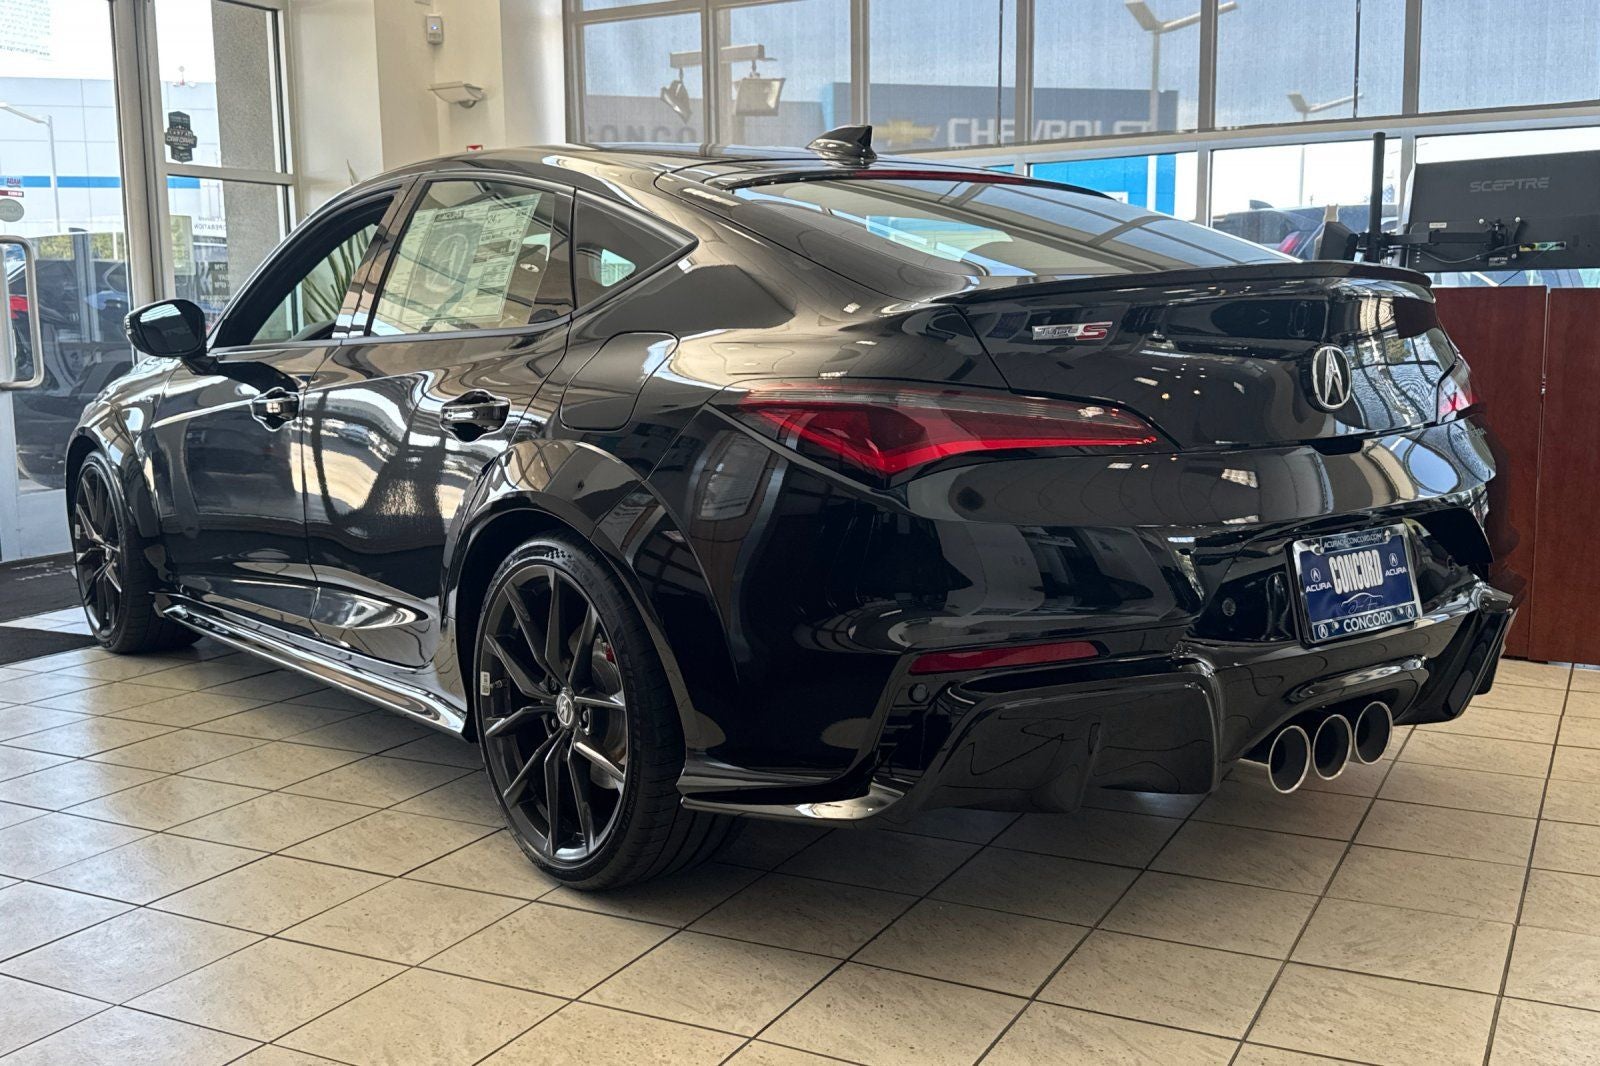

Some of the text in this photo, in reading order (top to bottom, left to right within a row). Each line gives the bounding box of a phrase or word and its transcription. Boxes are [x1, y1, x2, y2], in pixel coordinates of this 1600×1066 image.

[1469, 176, 1550, 193] SCEPTRE
[1328, 549, 1384, 594] CONCORD
[1385, 567, 1407, 576] ACURA
[1305, 581, 1332, 593] ACURA
[1343, 611, 1392, 632] CONCORD
